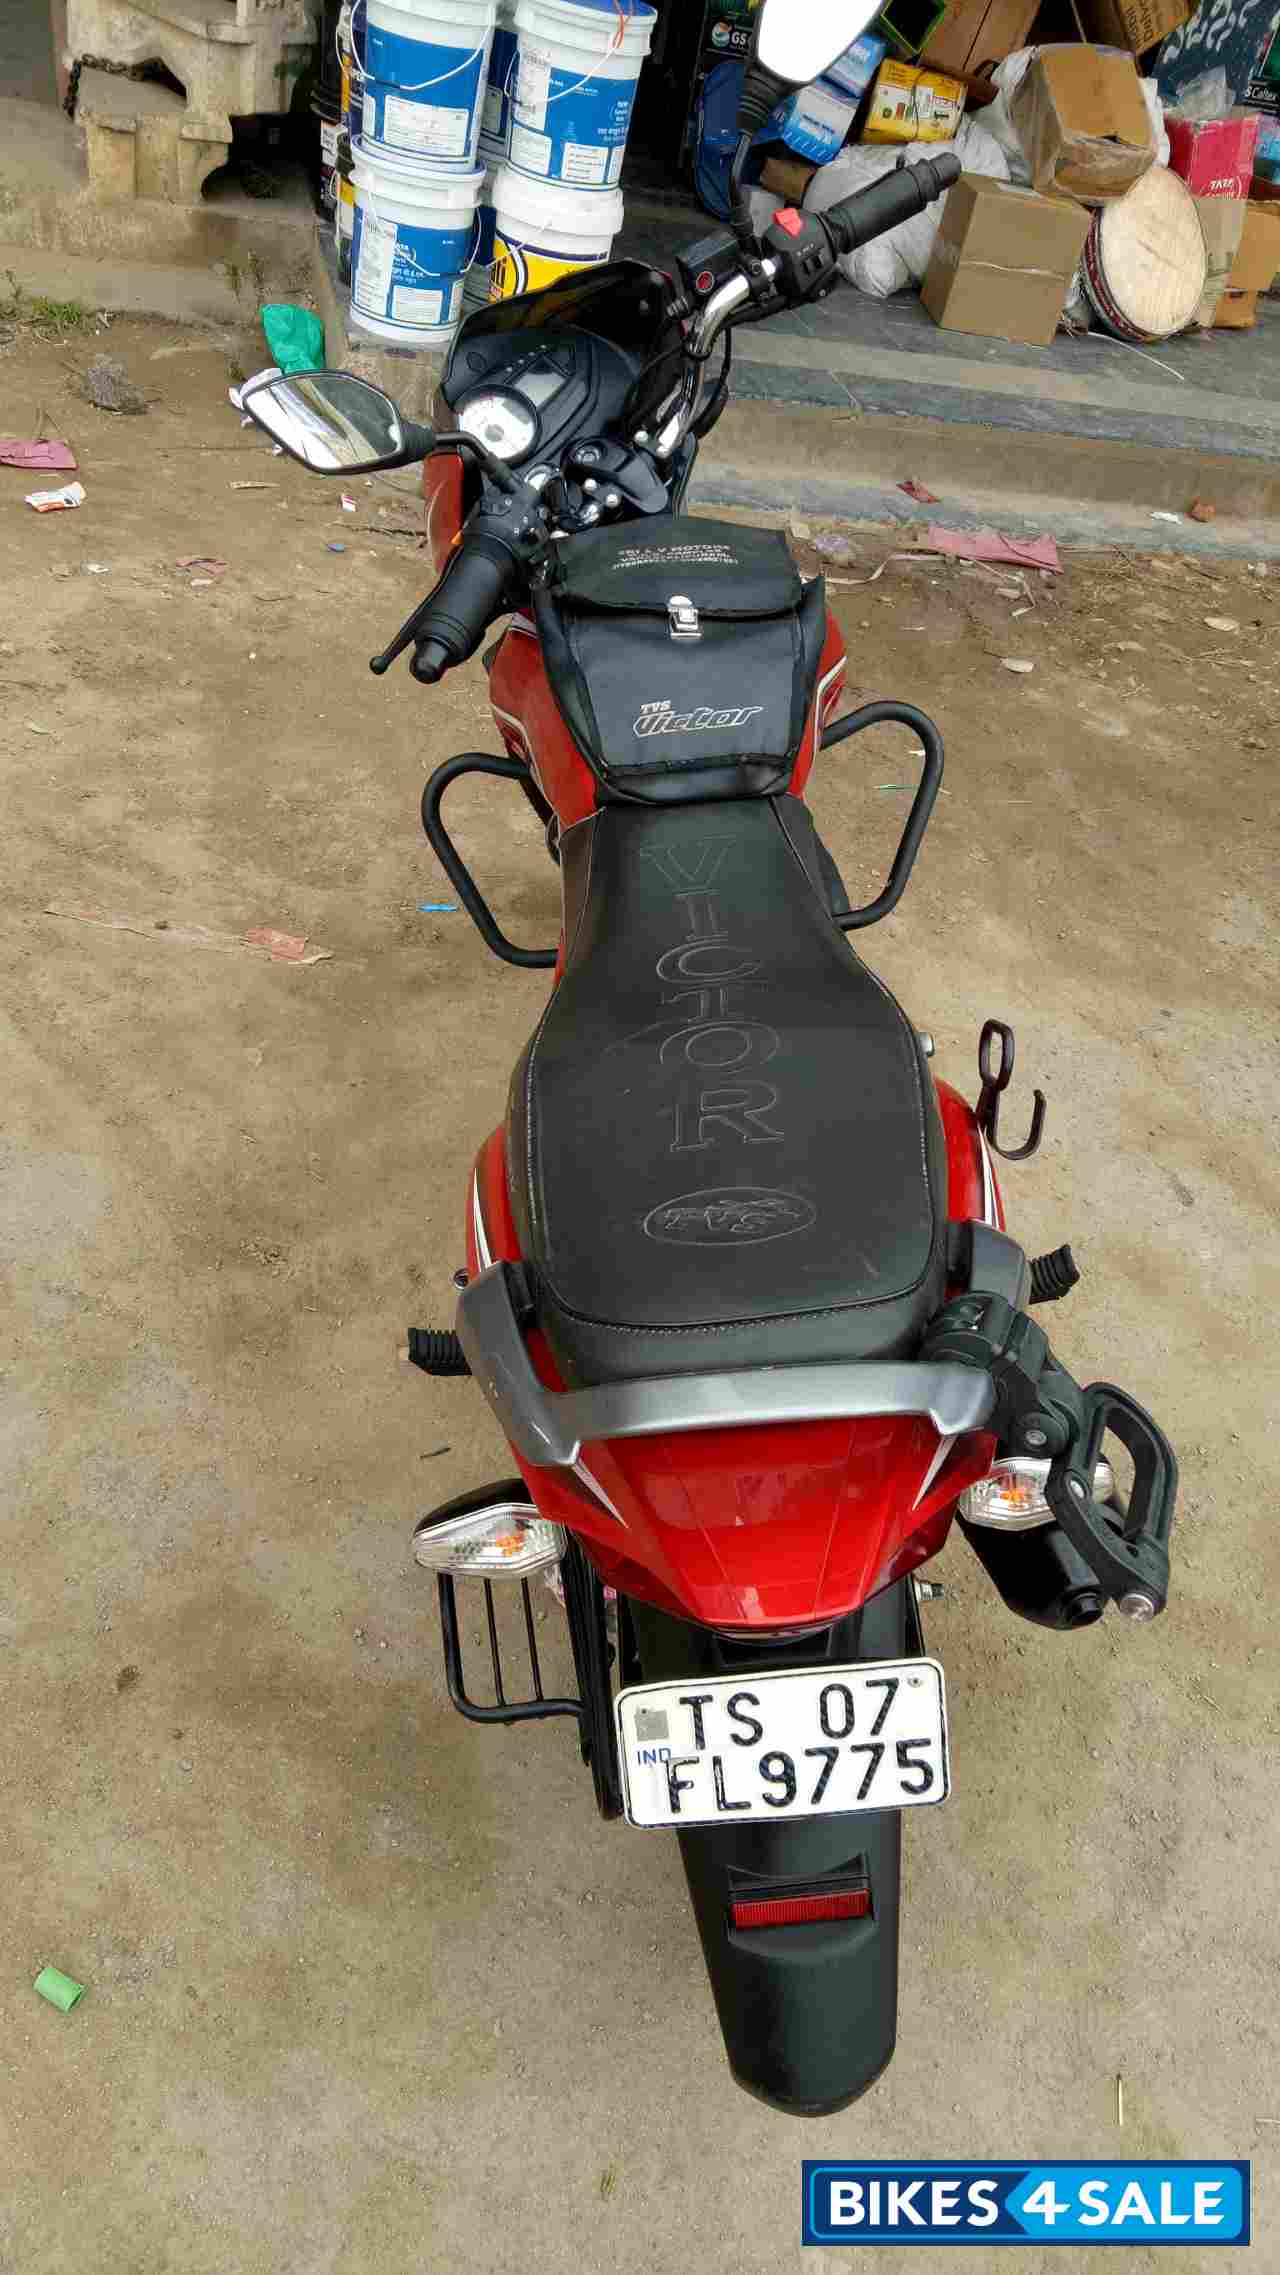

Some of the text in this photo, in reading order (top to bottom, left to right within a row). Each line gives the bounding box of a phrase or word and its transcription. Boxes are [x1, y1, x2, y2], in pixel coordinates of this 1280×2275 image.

[731, 31, 747, 46] GS
[640, 700, 671, 714] TVS
[633, 706, 763, 737] Victor
[679, 1677, 900, 1751] TS 07
[637, 1747, 672, 1766] IND
[664, 1737, 935, 1814] FL9775
